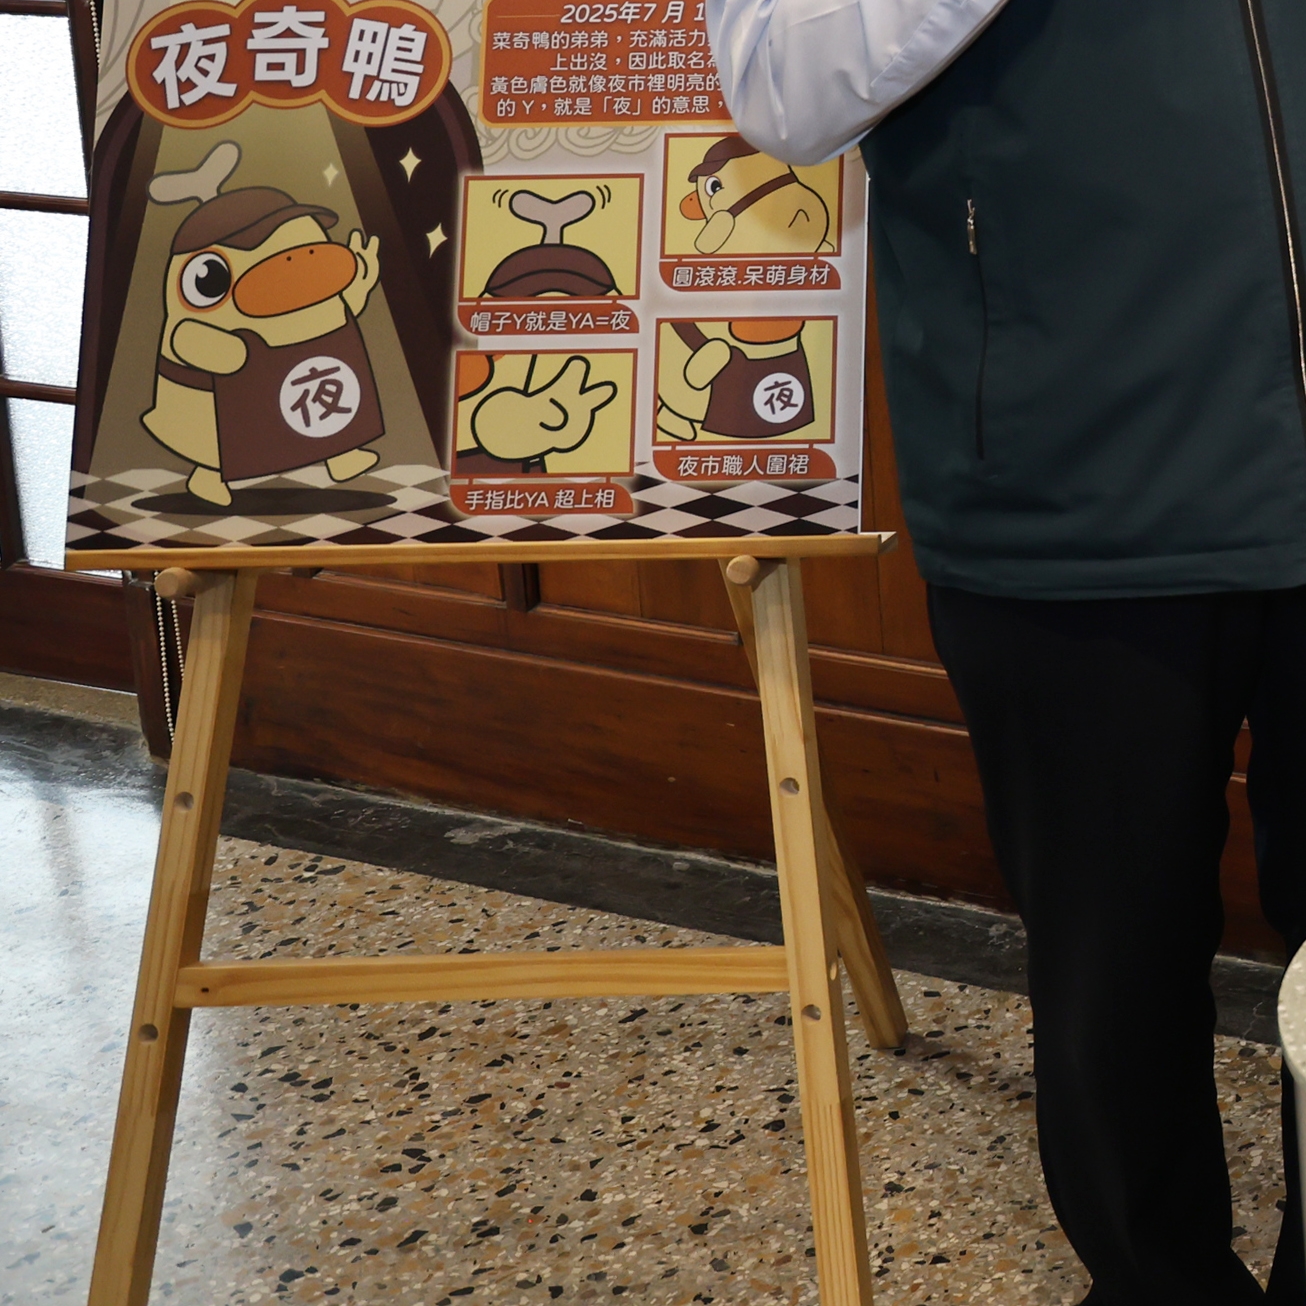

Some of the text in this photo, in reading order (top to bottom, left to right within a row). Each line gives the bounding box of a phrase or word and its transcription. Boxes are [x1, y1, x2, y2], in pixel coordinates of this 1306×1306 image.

[491, 28, 712, 51] 菜奇鴨的弟弟，充滿活力
[150, 5, 428, 110] 夜奇鴨
[671, 264, 831, 287] 圓滾滾.呆萌身材
[469, 310, 632, 333] 帽子Y就是YA=夜
[289, 365, 353, 428] 夜
[762, 380, 800, 415] 夜
[676, 454, 810, 478] 夜市職人圍裙
[464, 487, 616, 511] 手指比YA 超上相
